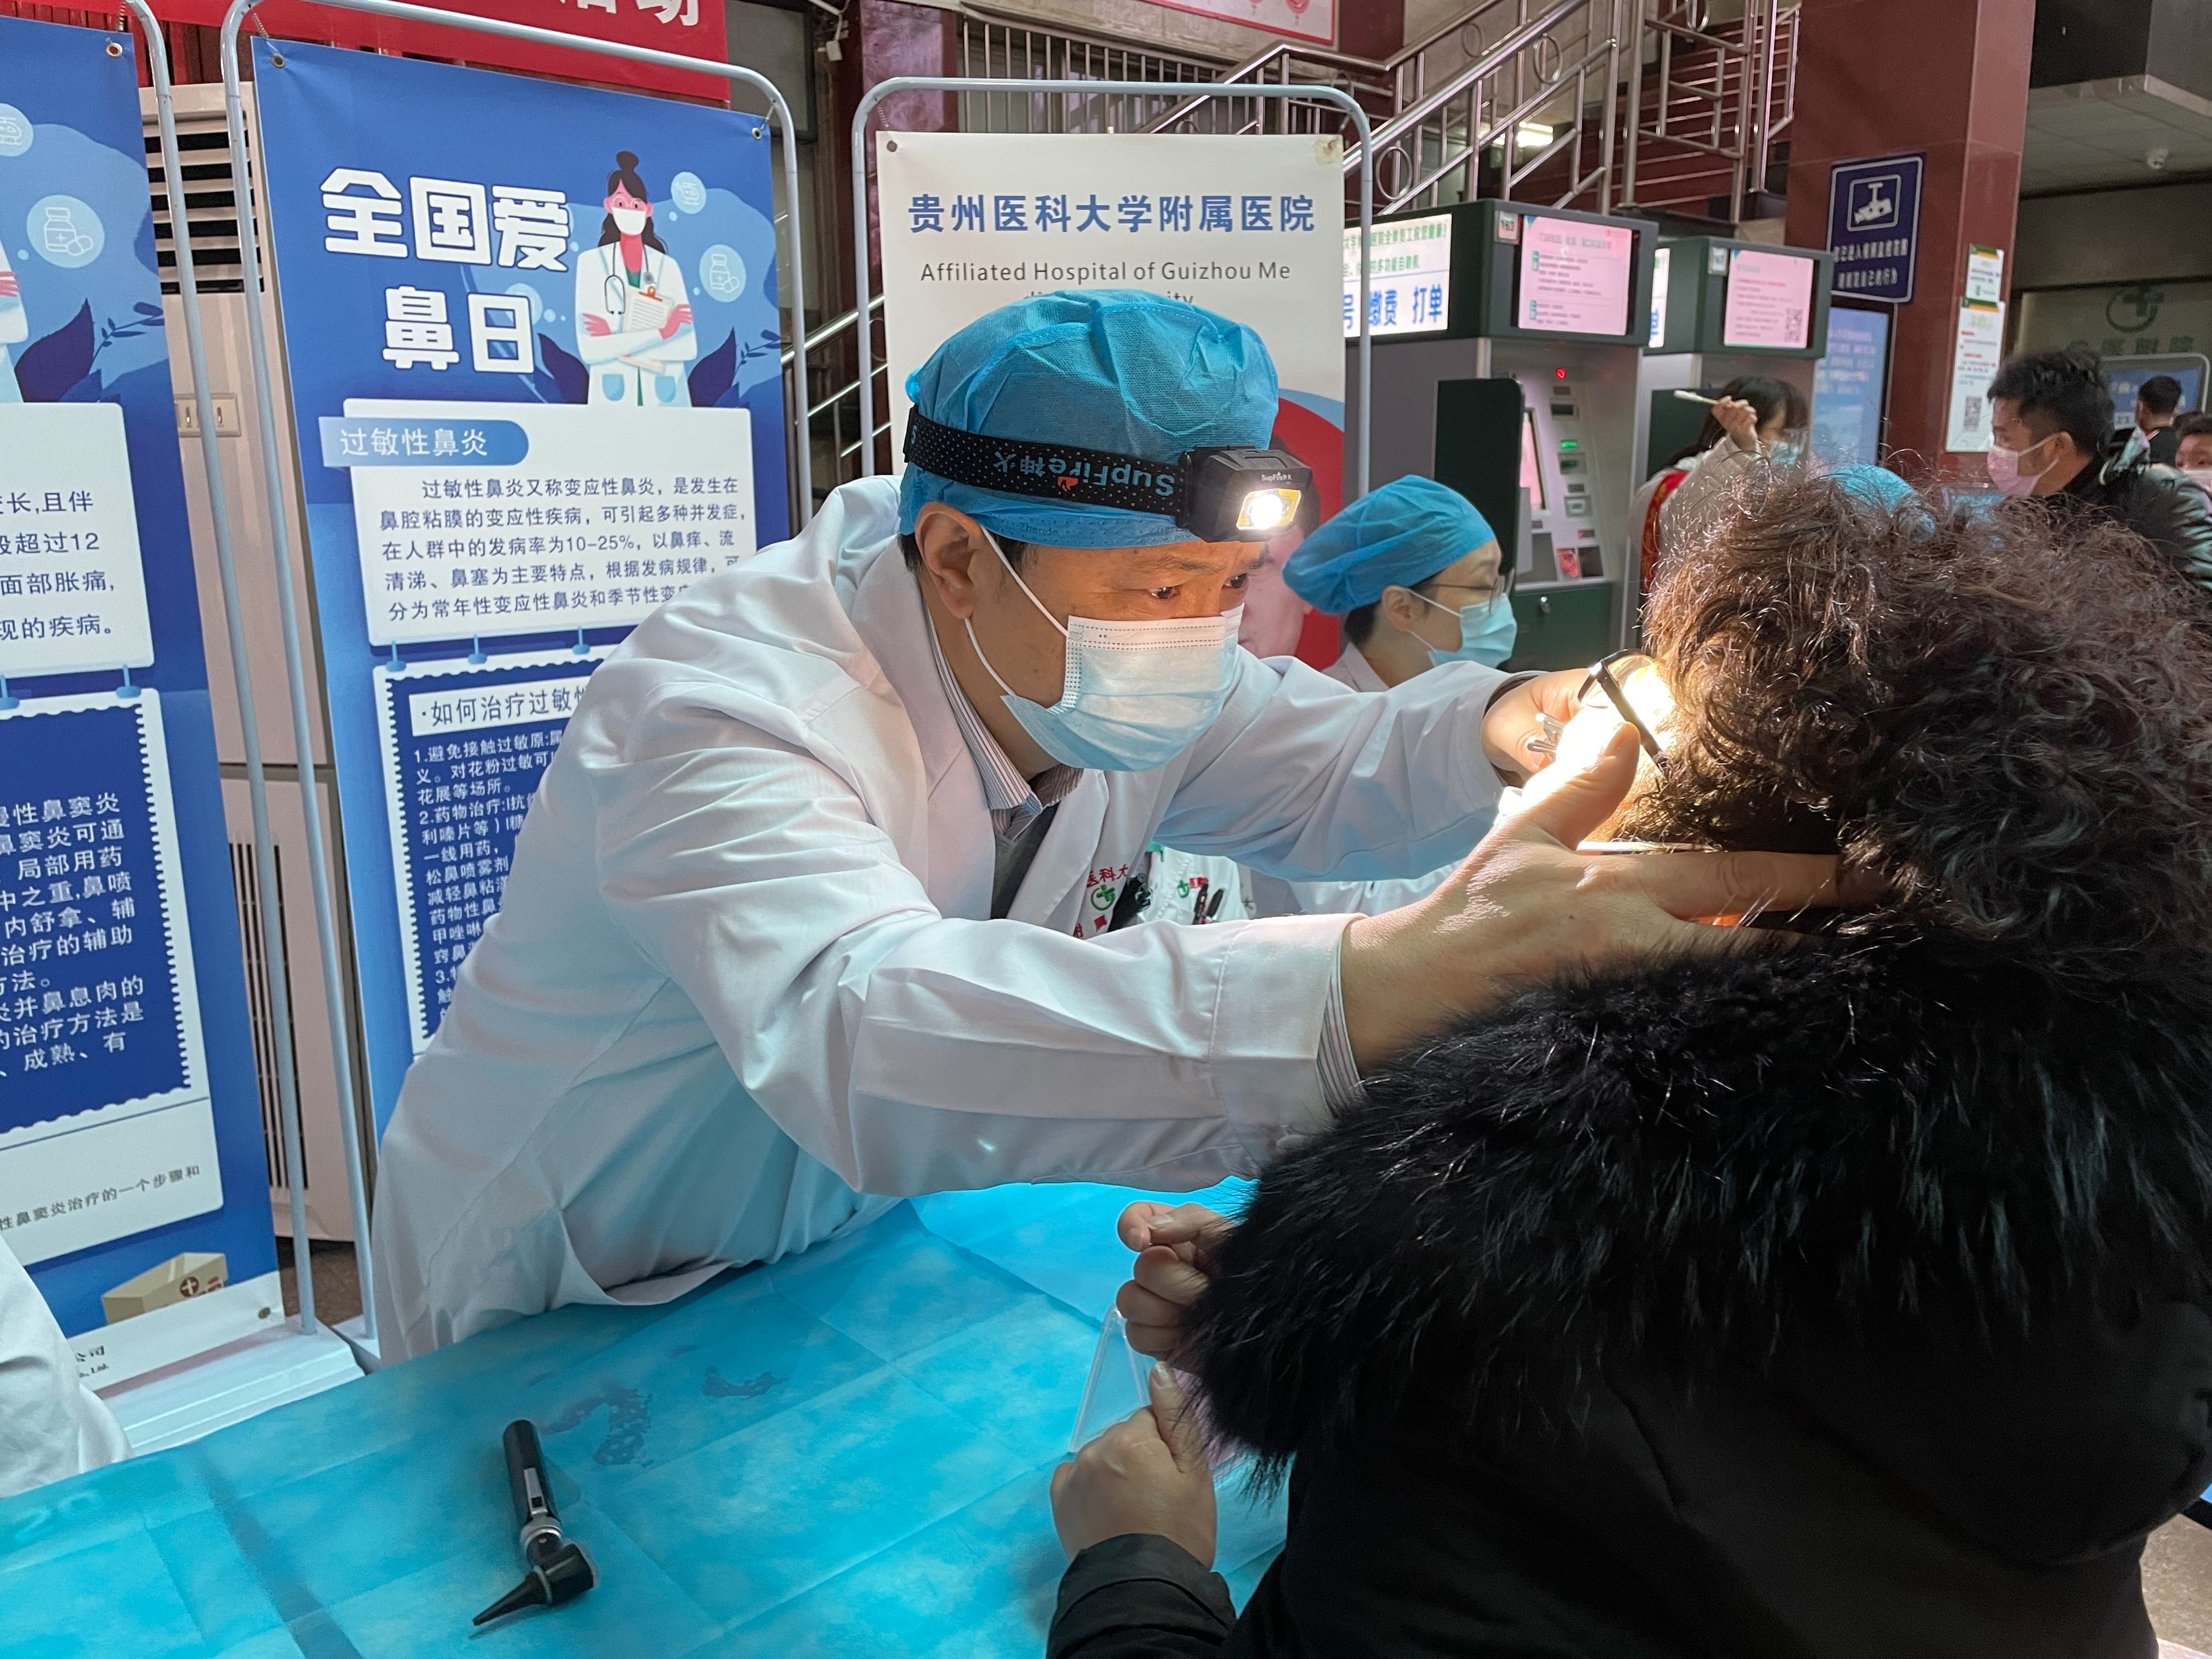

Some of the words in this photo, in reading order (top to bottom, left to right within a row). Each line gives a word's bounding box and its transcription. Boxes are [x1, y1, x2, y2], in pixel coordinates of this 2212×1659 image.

[320, 168, 569, 272] 全国爱
[909, 194, 1314, 233] 贵州医科大学附属医院
[921, 262, 1026, 281] Affiliated
[1034, 261, 1126, 285] Hospital
[1133, 261, 1155, 280] of
[1161, 261, 1251, 280] Guizhou
[1259, 262, 1290, 279] Me
[1413, 284, 1442, 324] 打单
[383, 286, 534, 373] 鼻日
[340, 427, 488, 456] 过敏性鼻炎
[0, 490, 93, 514] 长,且伴
[0, 614, 111, 641] 现的疾病。
[416, 751, 554, 786] 义。对花粉过敏可
[417, 777, 511, 806] 花展等场所。
[18, 845, 122, 881] 局部用药
[426, 855, 509, 886] 松鼻喷雾剂
[428, 896, 503, 926] 药物性鼻
[1, 924, 133, 966] 治疗的辅助
